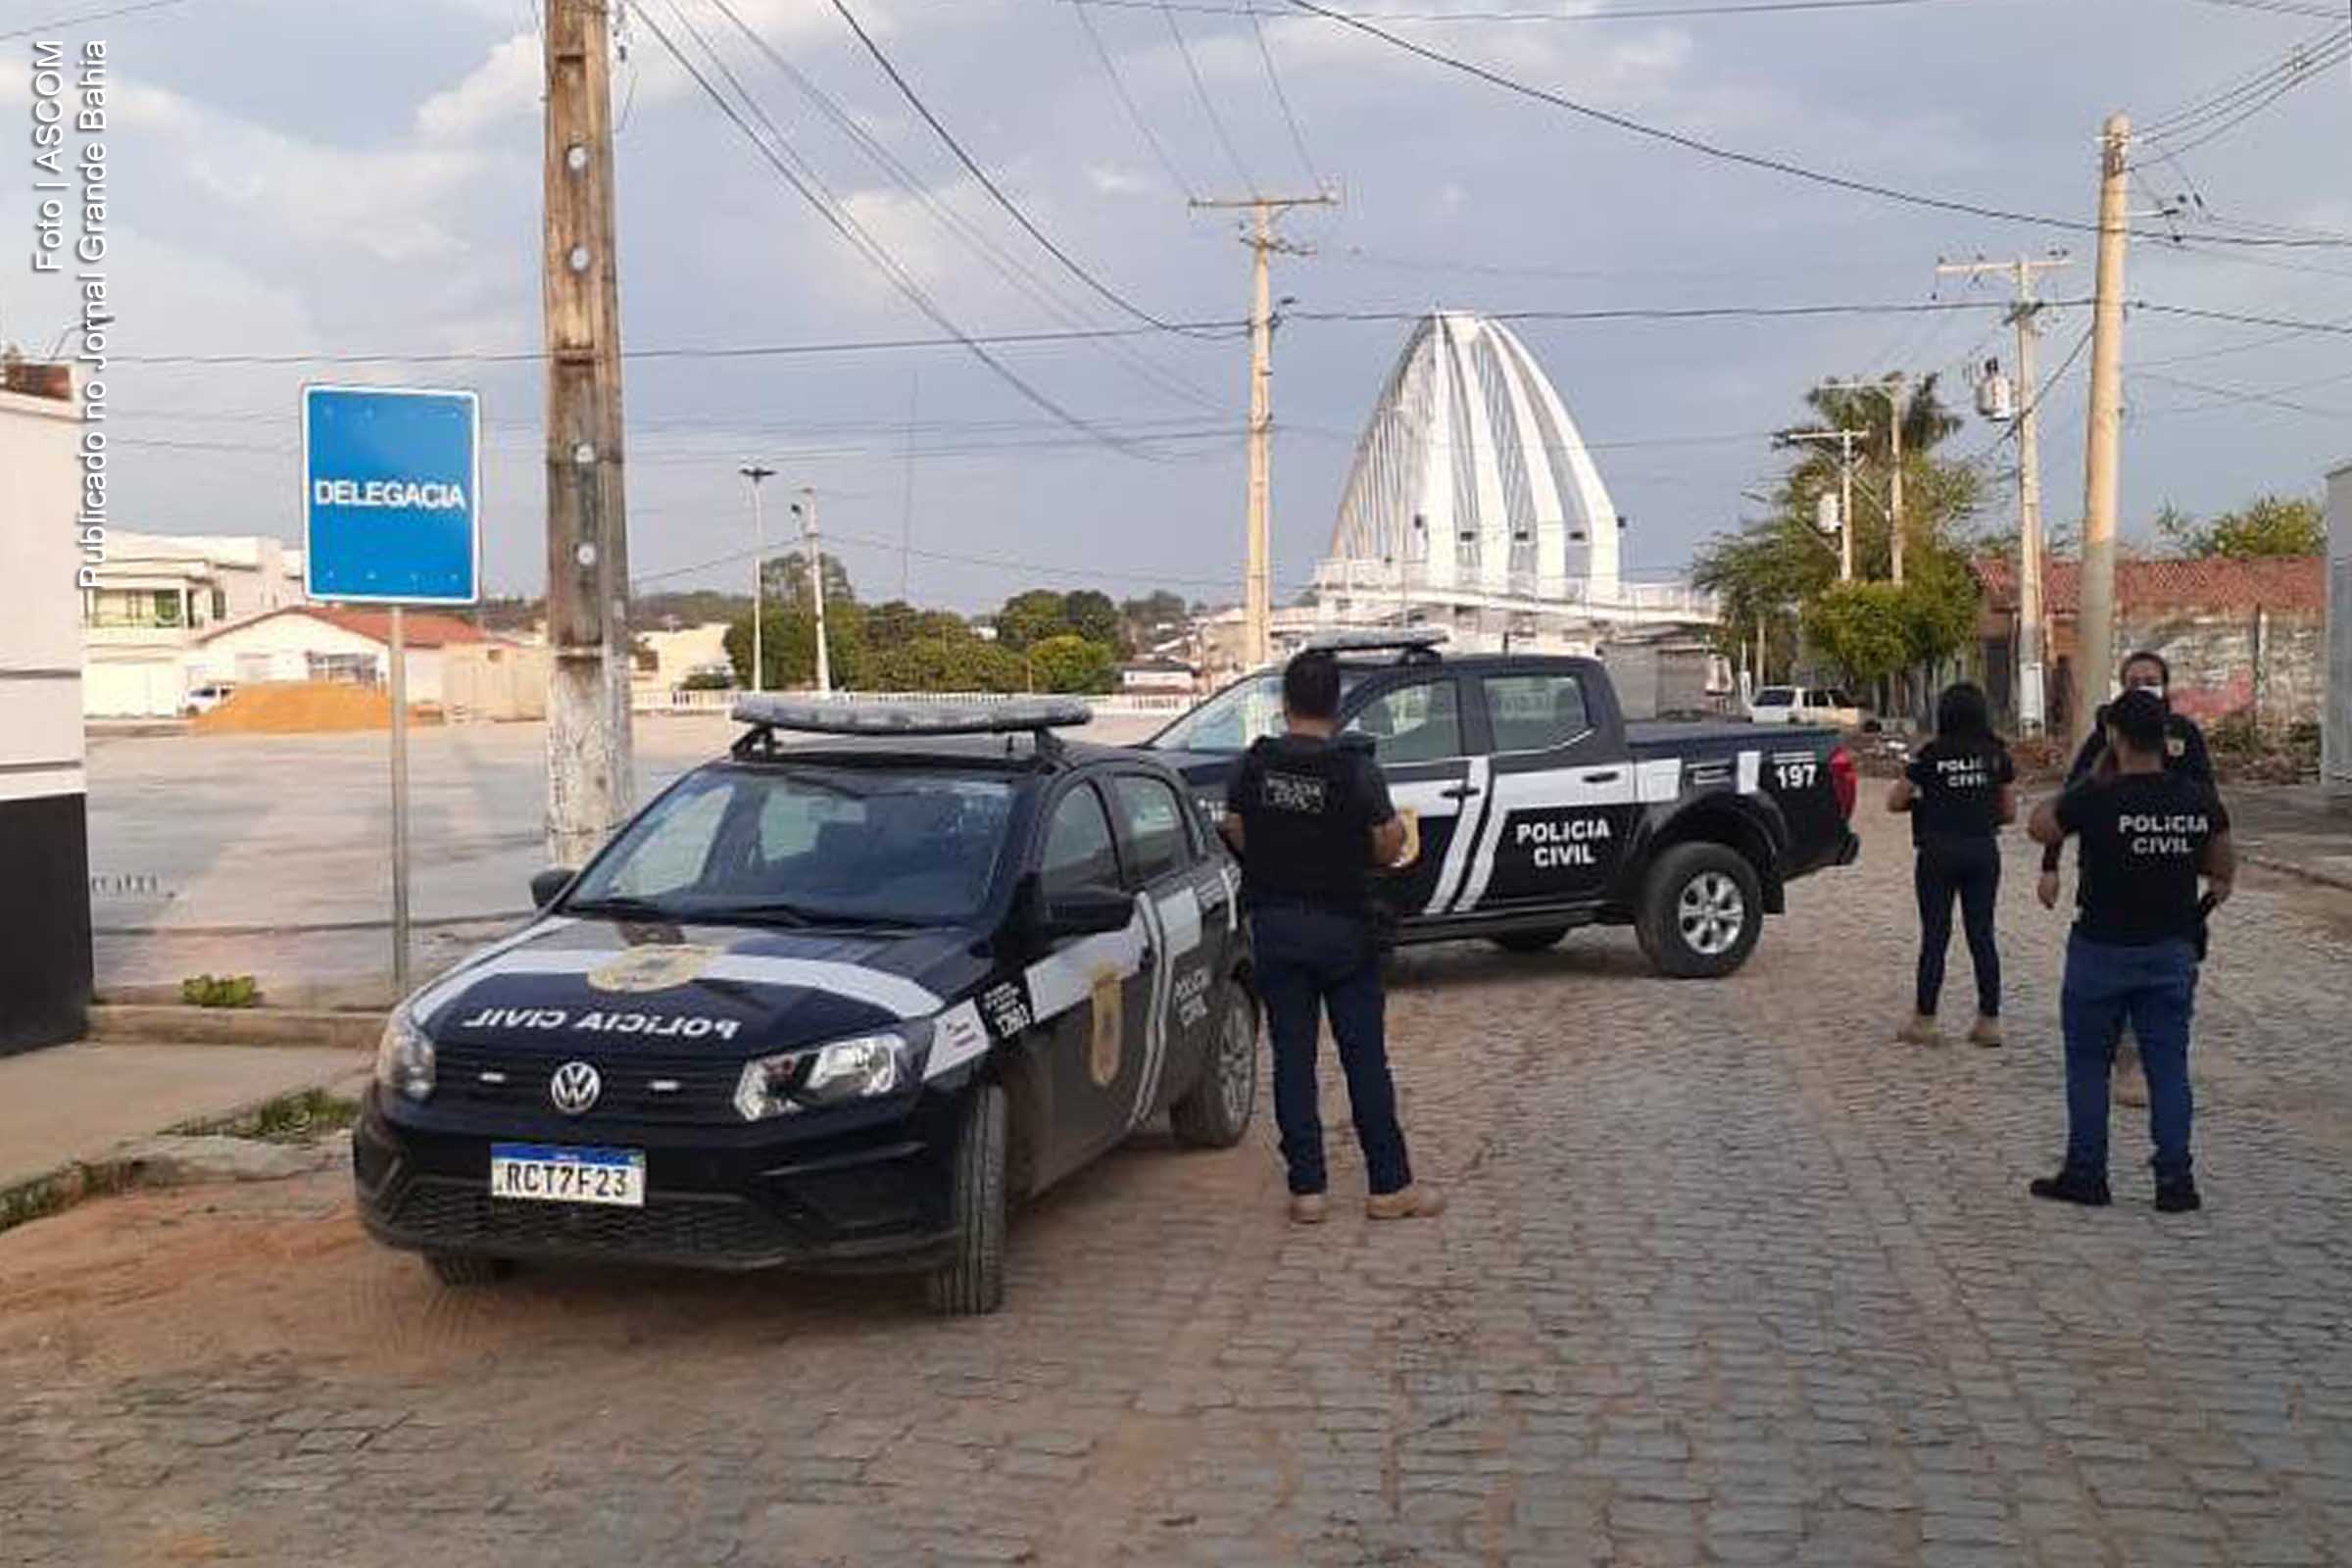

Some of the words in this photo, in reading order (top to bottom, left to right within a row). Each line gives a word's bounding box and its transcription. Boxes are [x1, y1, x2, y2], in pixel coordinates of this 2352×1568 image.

[315, 479, 466, 511] DELEGACIA
[1776, 764, 1817, 790] 197
[1533, 844, 1597, 868] CIVIL
[2132, 837, 2196, 855] CIVIL
[507, 1162, 628, 1198] RCT7F23
